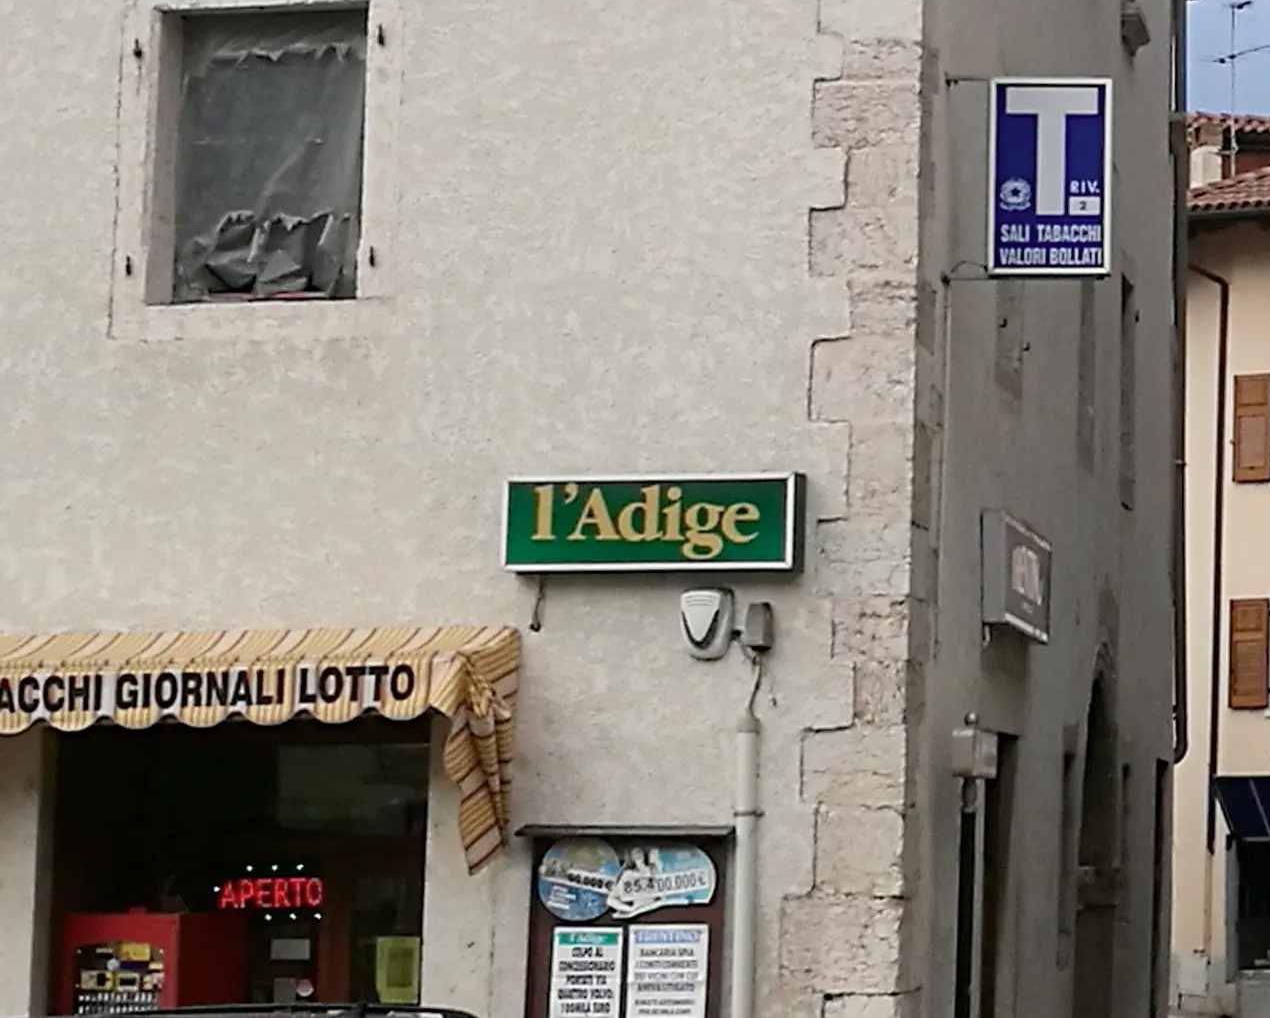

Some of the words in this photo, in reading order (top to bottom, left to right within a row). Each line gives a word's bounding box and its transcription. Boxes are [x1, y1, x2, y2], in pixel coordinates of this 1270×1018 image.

[1005, 87, 1099, 216] T
[1070, 180, 1101, 194] RIV.
[1079, 201, 1087, 211] 2
[1000, 224, 1030, 243] SALI
[1035, 224, 1102, 243] TABACCHI
[999, 248, 1046, 265] VALORI
[1049, 248, 1103, 266] BOLLATI
[115, 668, 286, 711] GIORNALI
[299, 664, 415, 704] LOTTO
[219, 877, 323, 910] APERTO
